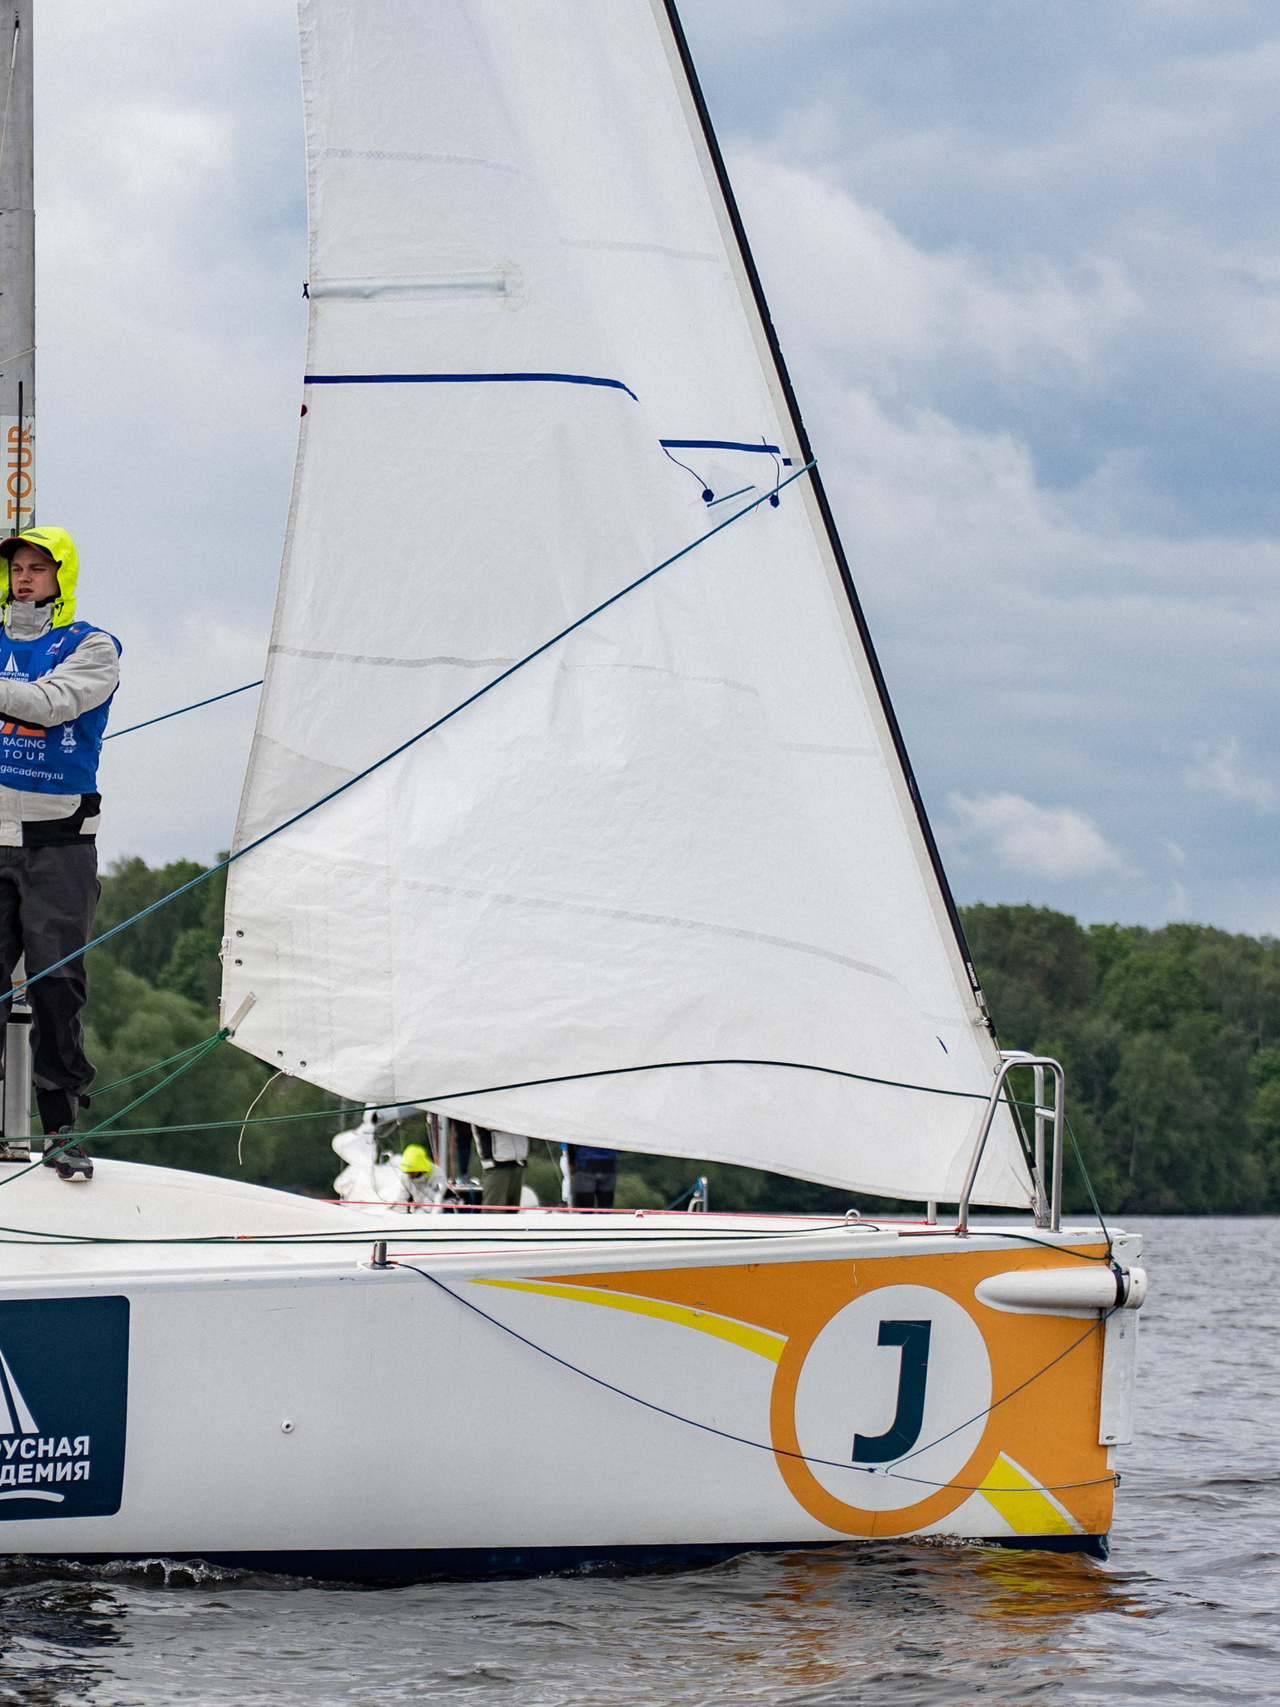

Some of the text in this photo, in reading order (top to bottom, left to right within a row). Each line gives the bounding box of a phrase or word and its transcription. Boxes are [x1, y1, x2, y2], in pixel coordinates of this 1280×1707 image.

[6, 422, 33, 520] TOUR
[3, 736, 47, 749] RACING
[4, 748, 45, 761] TOUR
[851, 1320, 932, 1463] J
